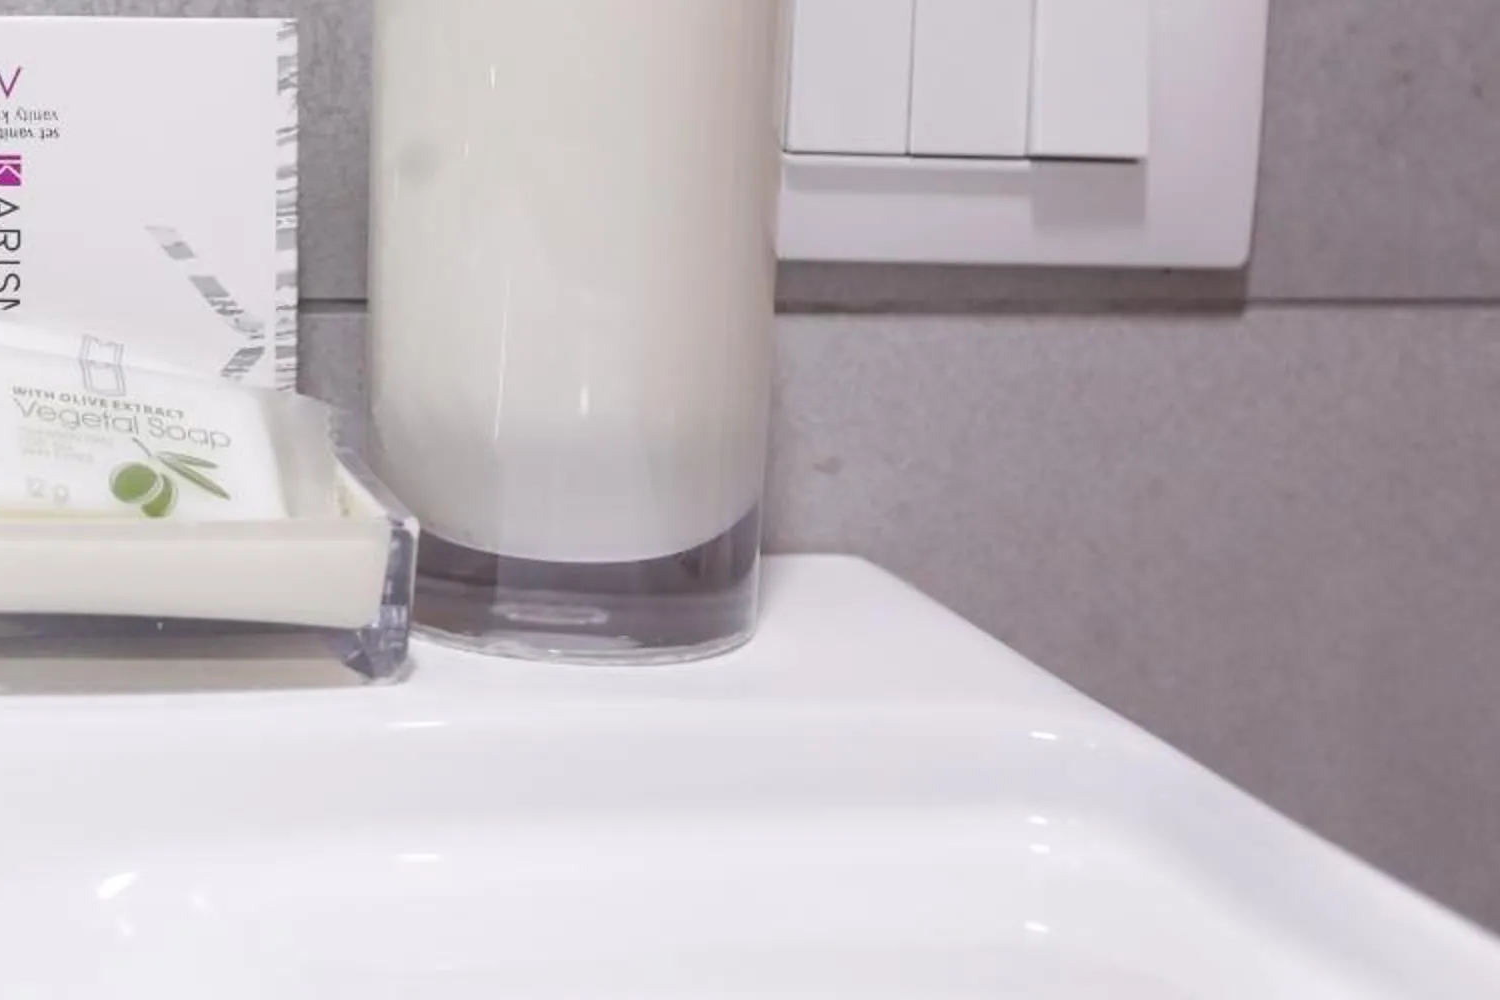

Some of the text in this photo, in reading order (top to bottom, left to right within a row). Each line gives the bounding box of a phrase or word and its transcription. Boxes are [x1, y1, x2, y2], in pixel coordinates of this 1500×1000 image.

[14, 106, 59, 124] vanity
[39, 128, 61, 141] set
[12, 385, 184, 420] WITH OLIVE EXTRACT
[13, 397, 140, 435] Vegetal
[147, 415, 232, 450] Soap
